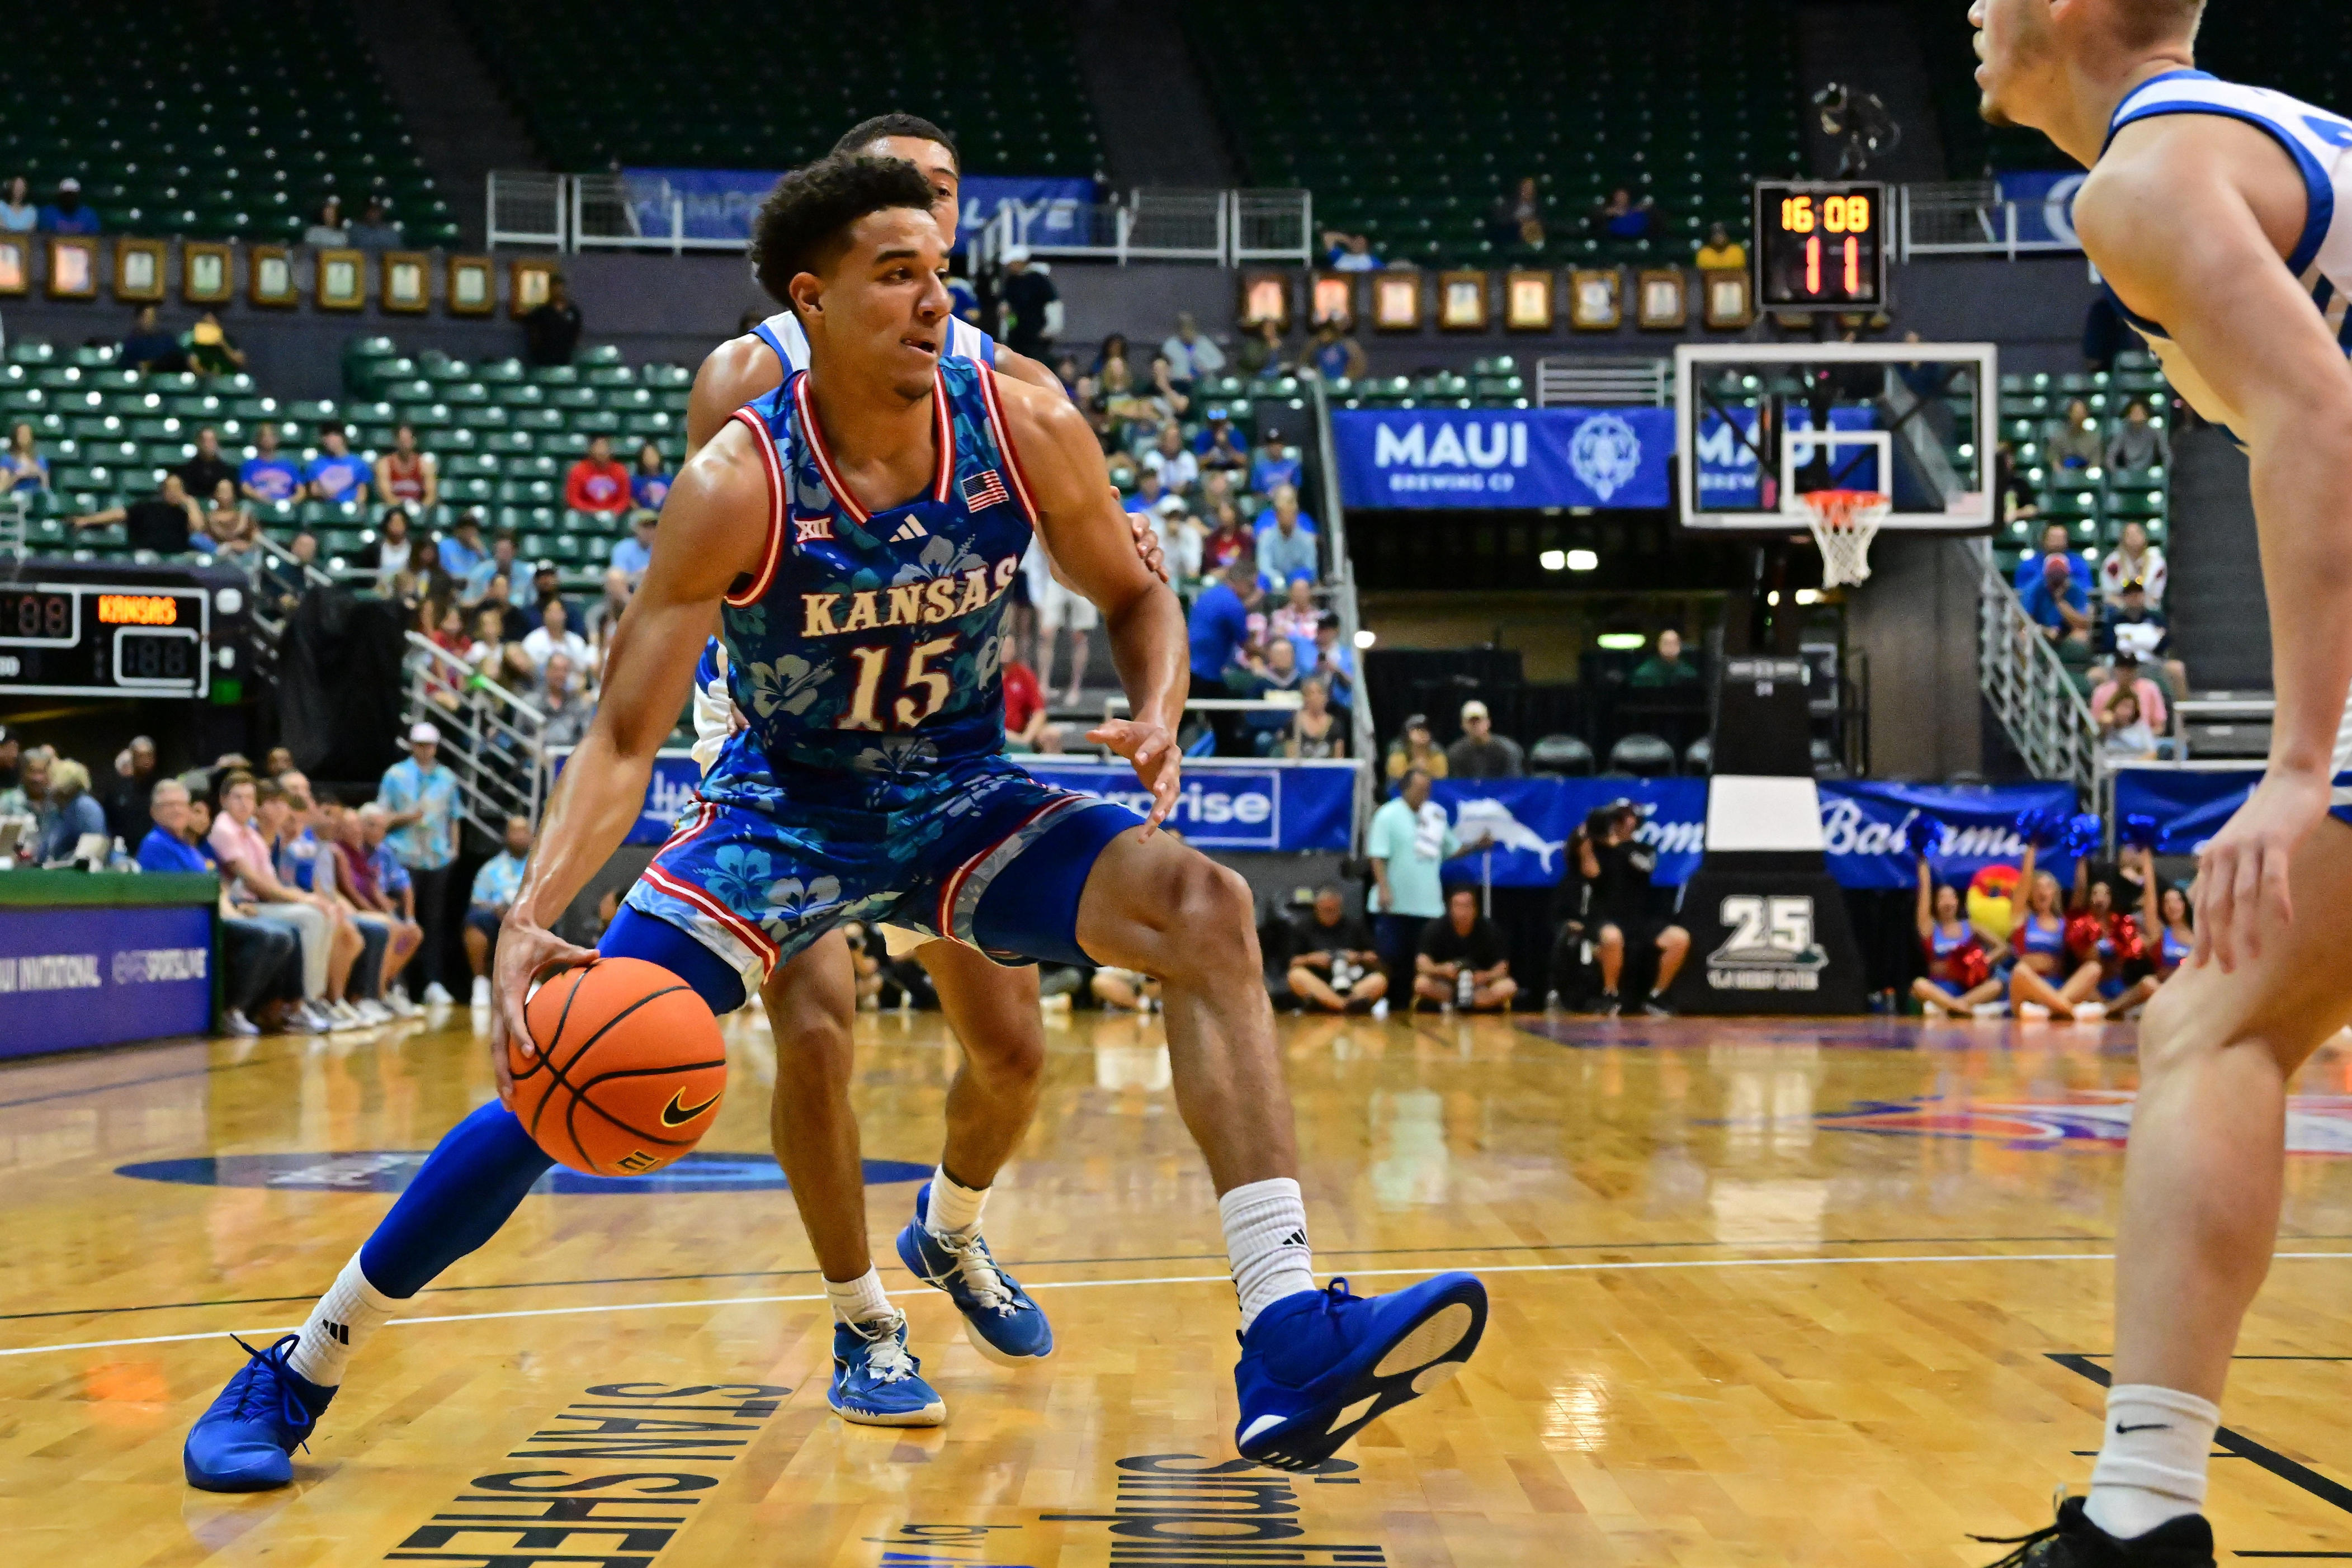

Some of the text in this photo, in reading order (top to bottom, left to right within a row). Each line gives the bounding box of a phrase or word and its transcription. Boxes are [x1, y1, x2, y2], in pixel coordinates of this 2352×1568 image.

[1782, 196, 1869, 233] 16:08
[1806, 235, 1858, 294] 11
[1374, 421, 1528, 468] MAUI
[98, 594, 177, 625] KANSAS
[800, 554, 1019, 637] KANSAS
[837, 632, 959, 731] 15
[1720, 895, 1814, 952] 25
[507, 1382, 793, 1461] STAN
[861, 1524, 1023, 1548] by
[1039, 1453, 1388, 1568] Simpli
